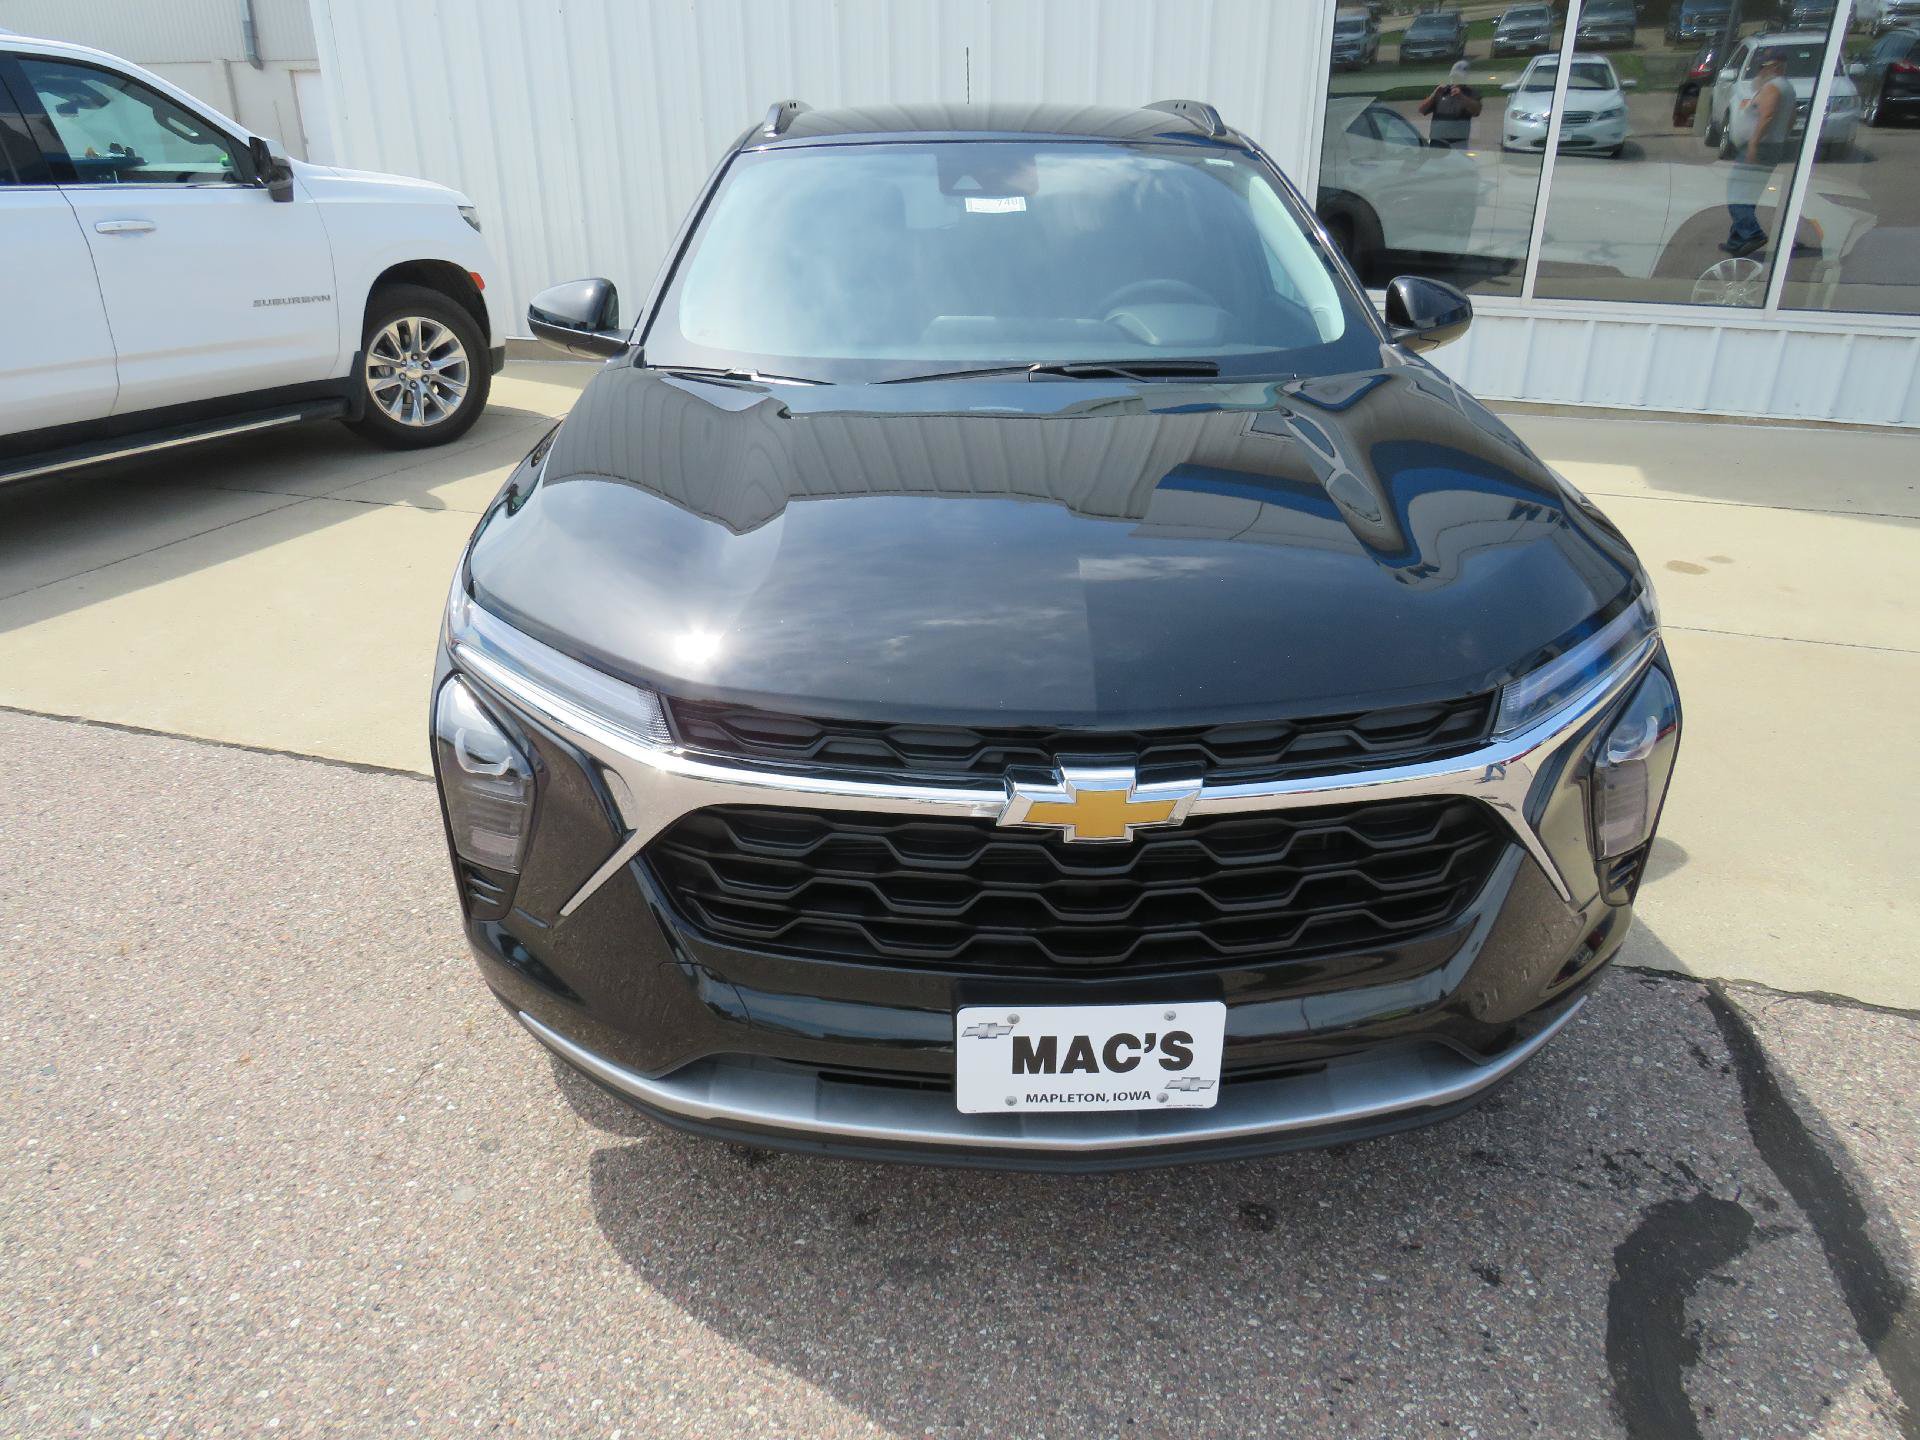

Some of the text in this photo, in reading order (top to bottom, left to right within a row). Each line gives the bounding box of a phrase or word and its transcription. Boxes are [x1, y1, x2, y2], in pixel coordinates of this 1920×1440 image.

[253, 295, 331, 308] SUBURBAN
[1012, 1031, 1194, 1074] MAC'S
[1025, 1091, 1152, 1104] MAPLETON, IOWA
